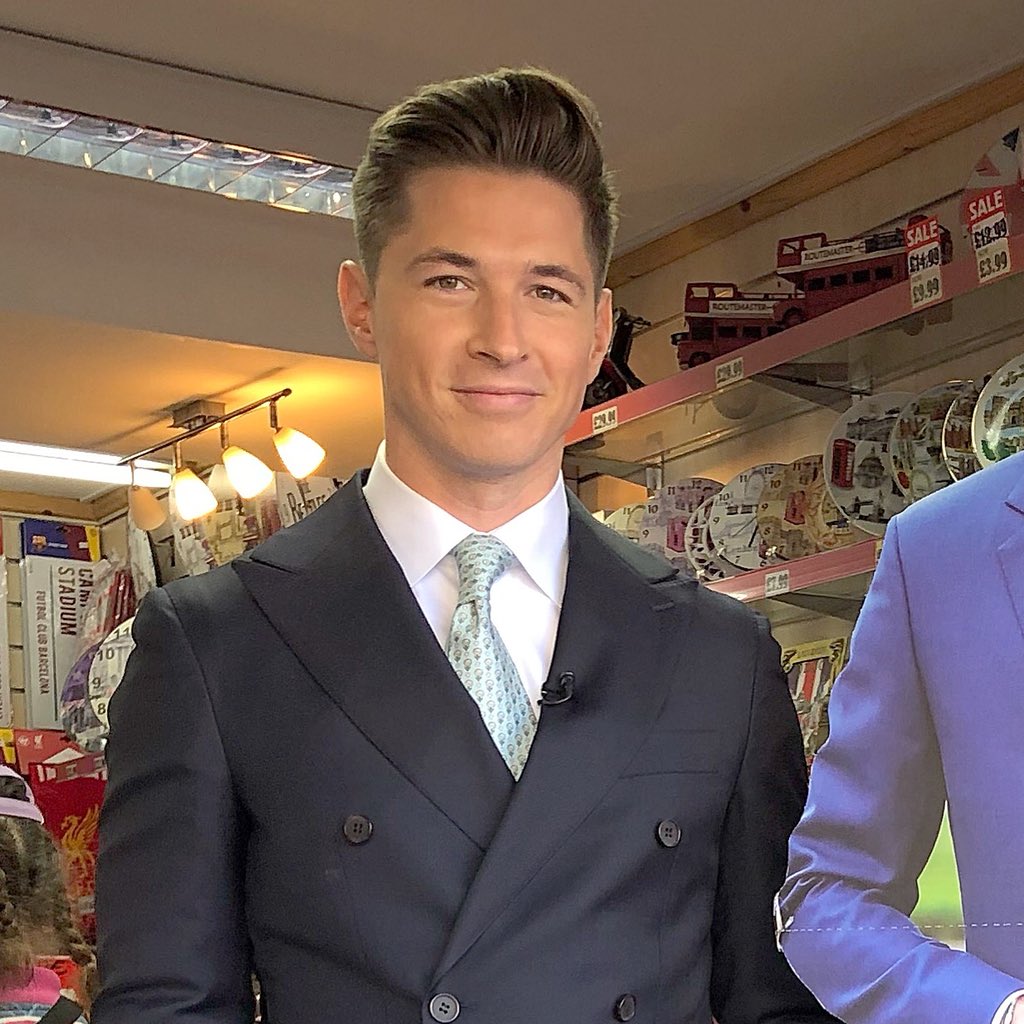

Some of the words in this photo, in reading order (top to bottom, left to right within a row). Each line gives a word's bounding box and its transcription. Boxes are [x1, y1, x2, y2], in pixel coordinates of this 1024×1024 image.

[969, 190, 1003, 220] SALE
[906, 220, 938, 247] SALE
[803, 244, 853, 261] ROUTEMASTER
[980, 252, 1008, 278] £3.99
[912, 278, 939, 303] £9.99
[712, 303, 768, 313] ROUTEMASTER
[58, 567, 77, 637] STADIUM
[37, 624, 47, 646] CLUB
[39, 647, 50, 695] BARCELONA
[92, 677, 101, 690] 9
[97, 703, 107, 715] 8
